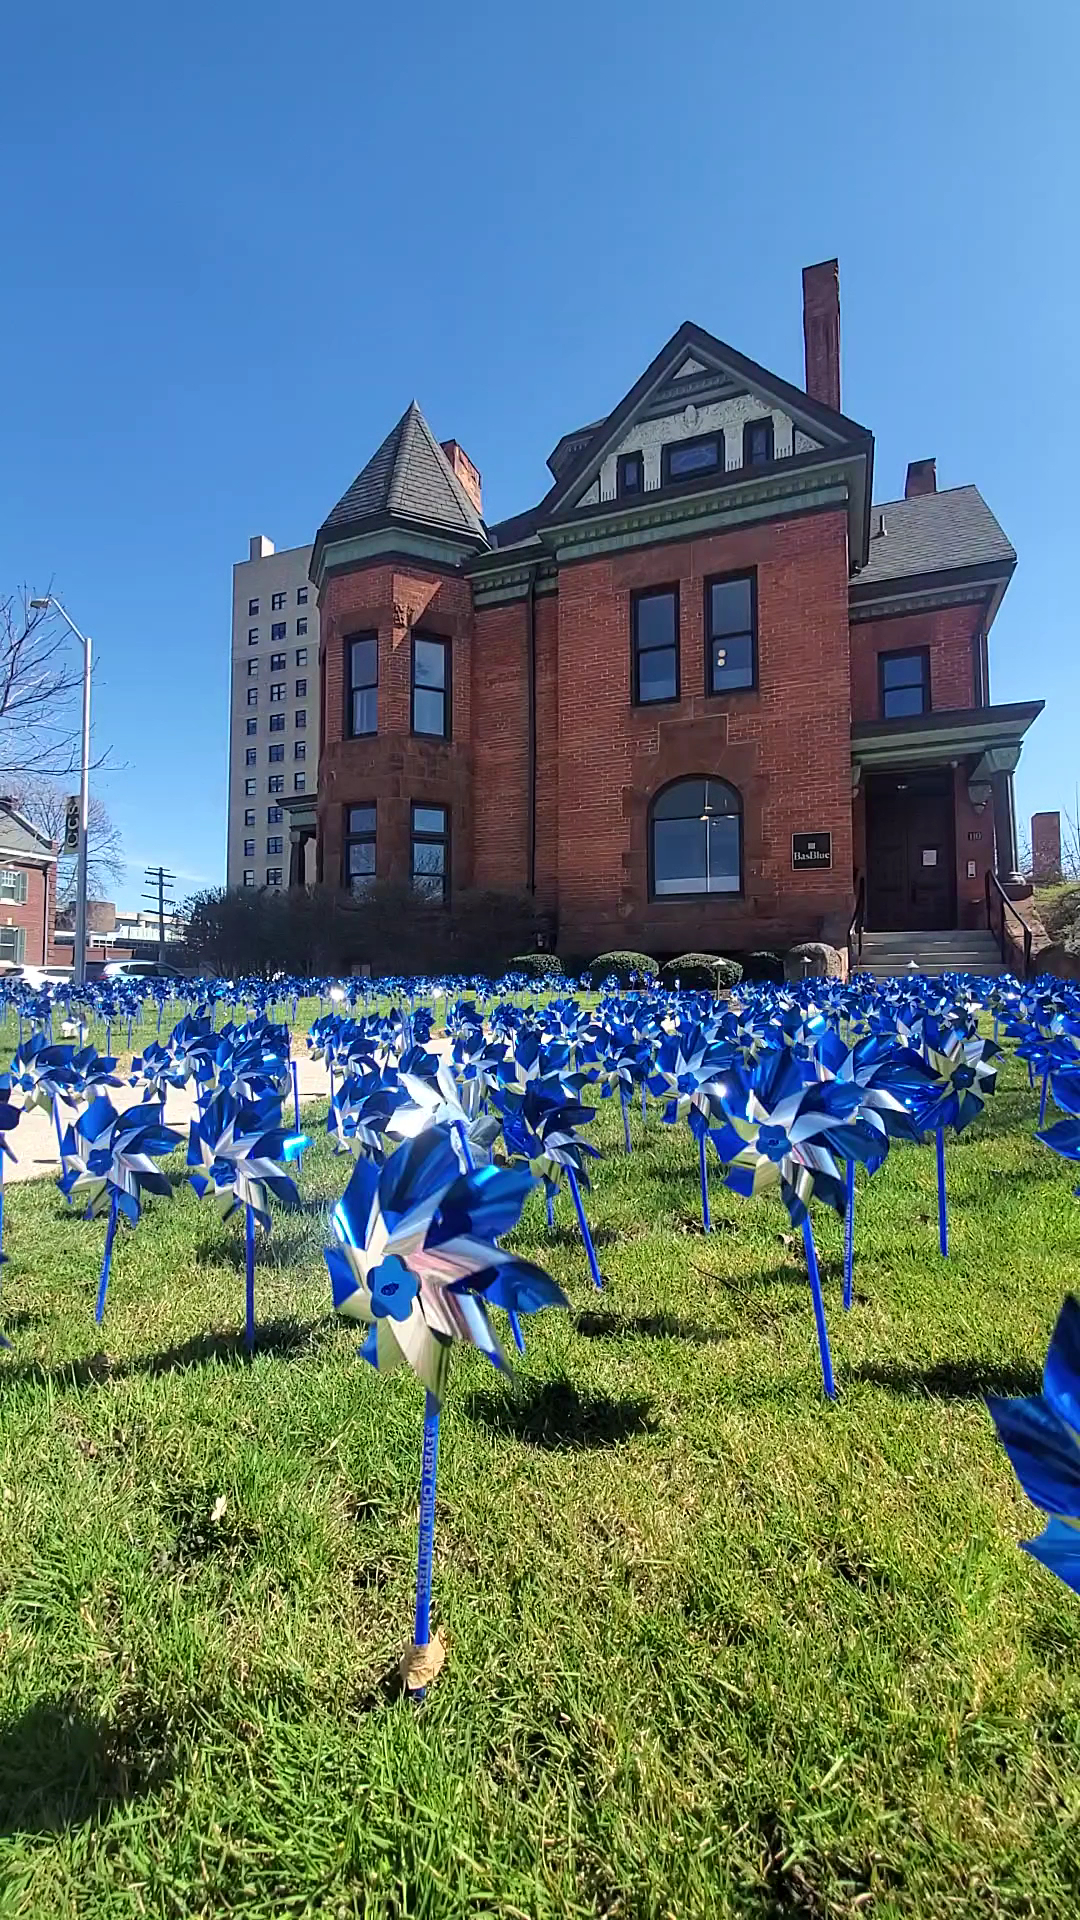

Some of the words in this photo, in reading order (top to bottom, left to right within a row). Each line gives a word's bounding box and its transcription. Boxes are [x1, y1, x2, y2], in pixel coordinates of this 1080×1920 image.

[67, 804, 78, 846] CCS
[794, 851, 830, 861] BasBlue
[424, 1437, 434, 1480] EVERY
[422, 1485, 432, 1526] CHILD
[419, 1530, 430, 1596] MATTERS
